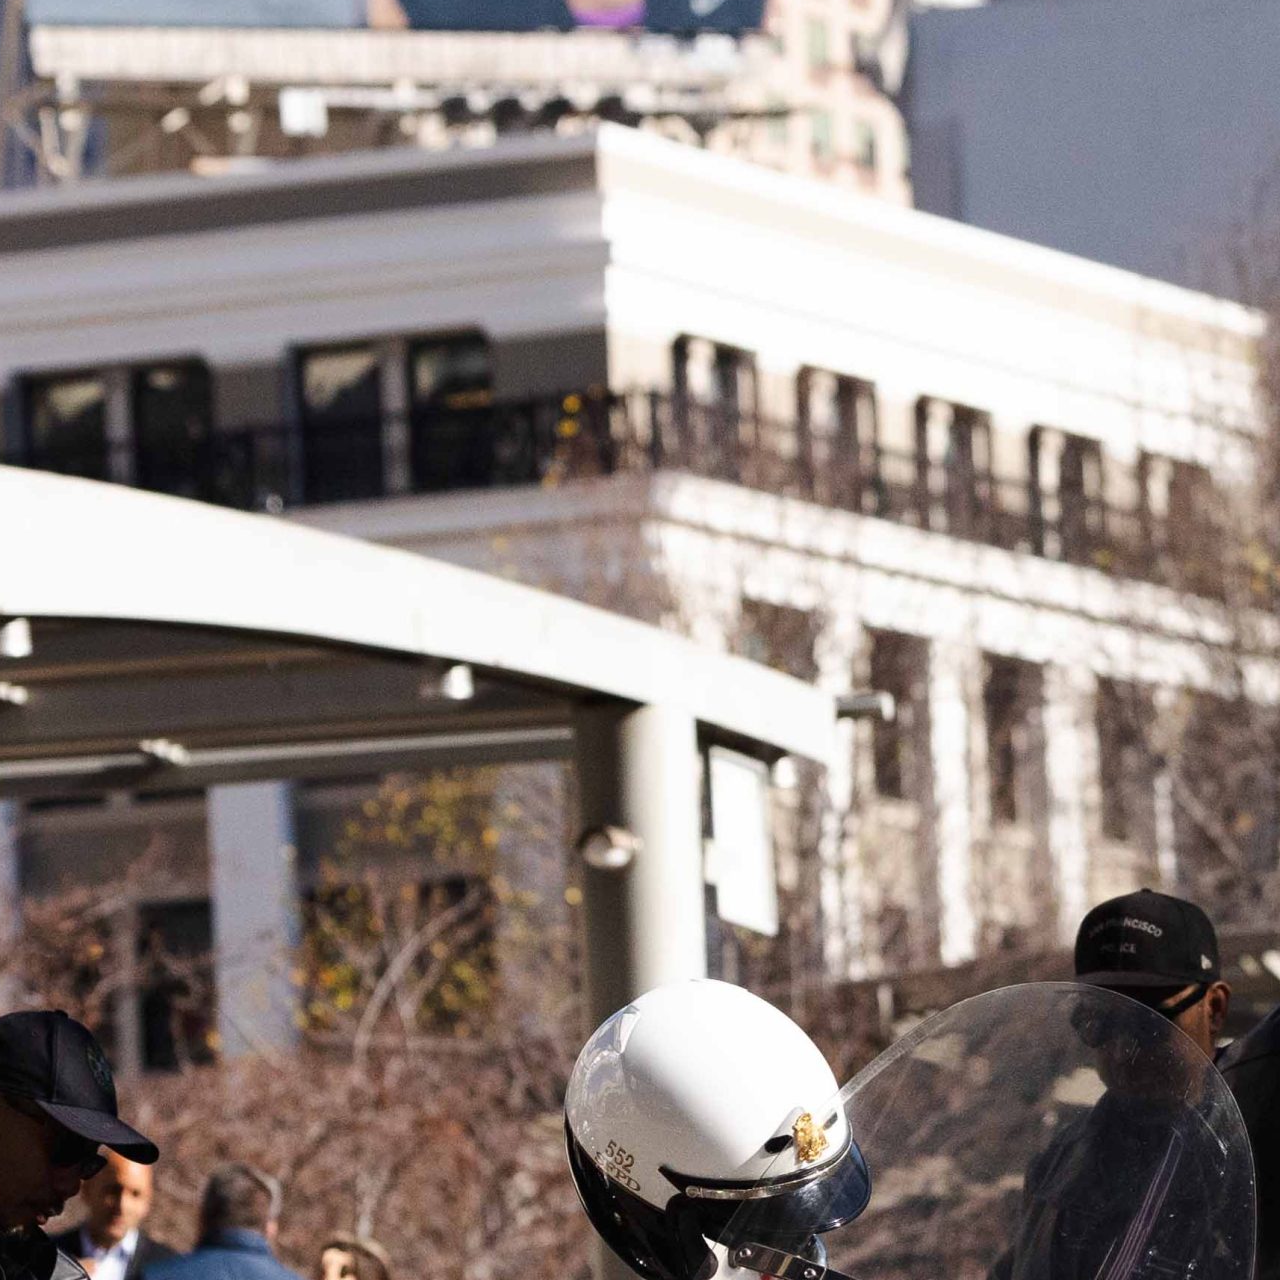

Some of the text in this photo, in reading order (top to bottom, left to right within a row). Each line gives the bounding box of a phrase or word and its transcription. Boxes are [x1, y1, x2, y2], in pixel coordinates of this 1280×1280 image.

[1106, 915, 1163, 938] NCISCO
[594, 1151, 641, 1192] SFPD
[605, 1139, 635, 1174] 552
